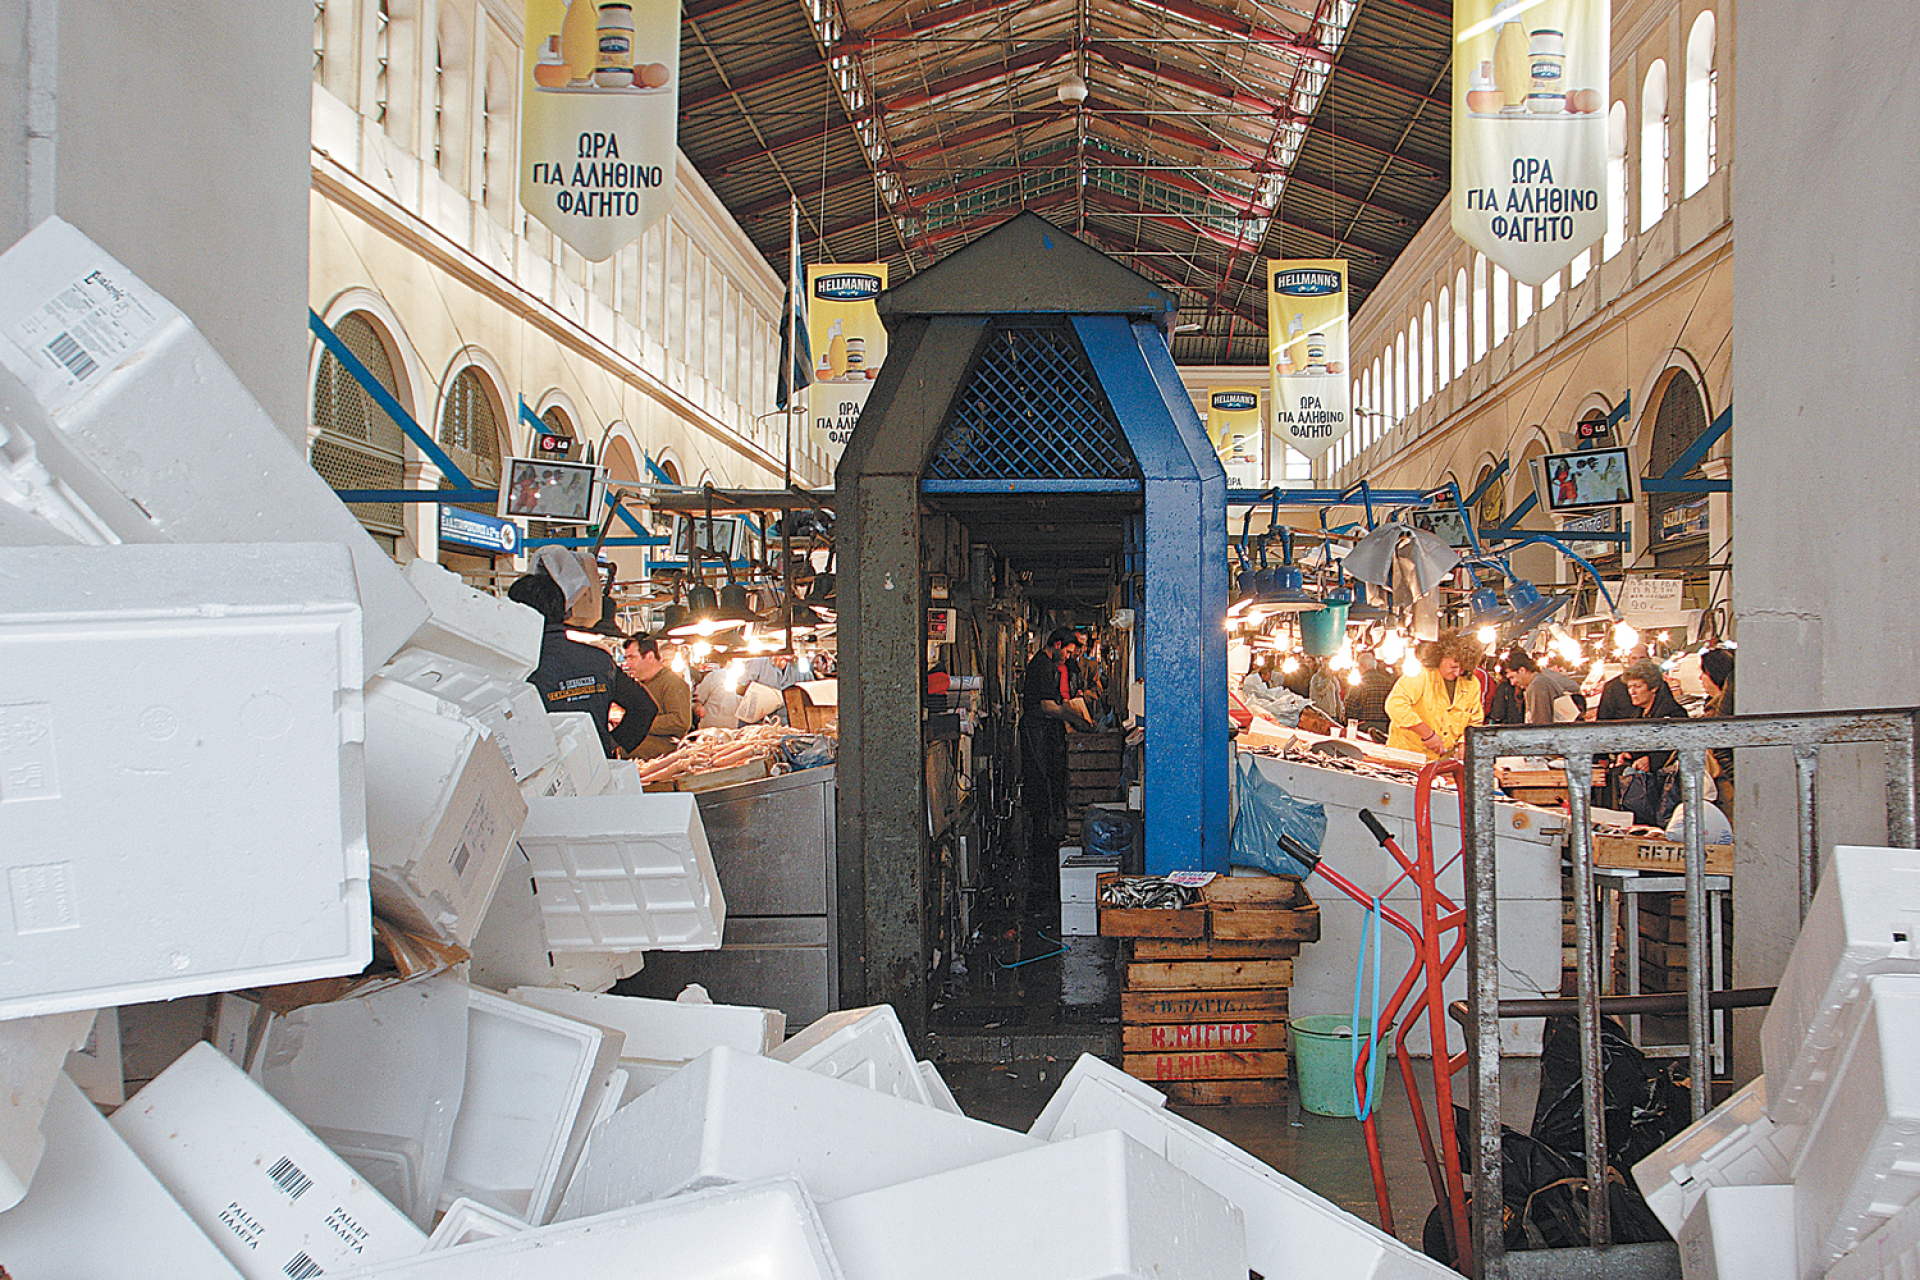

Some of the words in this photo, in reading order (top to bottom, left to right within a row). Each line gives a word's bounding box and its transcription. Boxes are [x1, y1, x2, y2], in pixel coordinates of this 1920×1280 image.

[577, 131, 619, 158] ΩΡΑ
[533, 163, 563, 186] ΓΙΑ
[571, 163, 663, 188] ΑΛΗΘΙΝΟ
[1511, 158, 1553, 185] ΩΡΑ
[556, 191, 639, 217] ΦΑΓΗΤΟ
[1466, 188, 1499, 213] ΓΙΑ
[1505, 187, 1599, 212] ΑΛΗΘΙΝΟ
[1490, 214, 1574, 243] ΦΑΓΗΤΟ
[818, 278, 878, 291] HELLMANN'S
[1277, 273, 1339, 288] HELLMANN'S
[838, 402, 860, 415] ΩΡΑ
[1213, 393, 1255, 406] HELLMANN'S
[1299, 396, 1322, 409] ΩΡΑ
[816, 417, 833, 430] ΓΙΑ
[1277, 411, 1295, 424] ΓΙΑ
[1297, 411, 1345, 424] ΑΛΗΘΙΝΟ
[1290, 424, 1332, 438] ΦΑΓΗΤΟ
[218, 1211, 258, 1249] ΠΑΛΕΤΑ
[228, 1201, 265, 1235] PALLET
[333, 1206, 370, 1240] PALLET
[324, 1215, 364, 1254] ΠΑΛΕΤΑ
